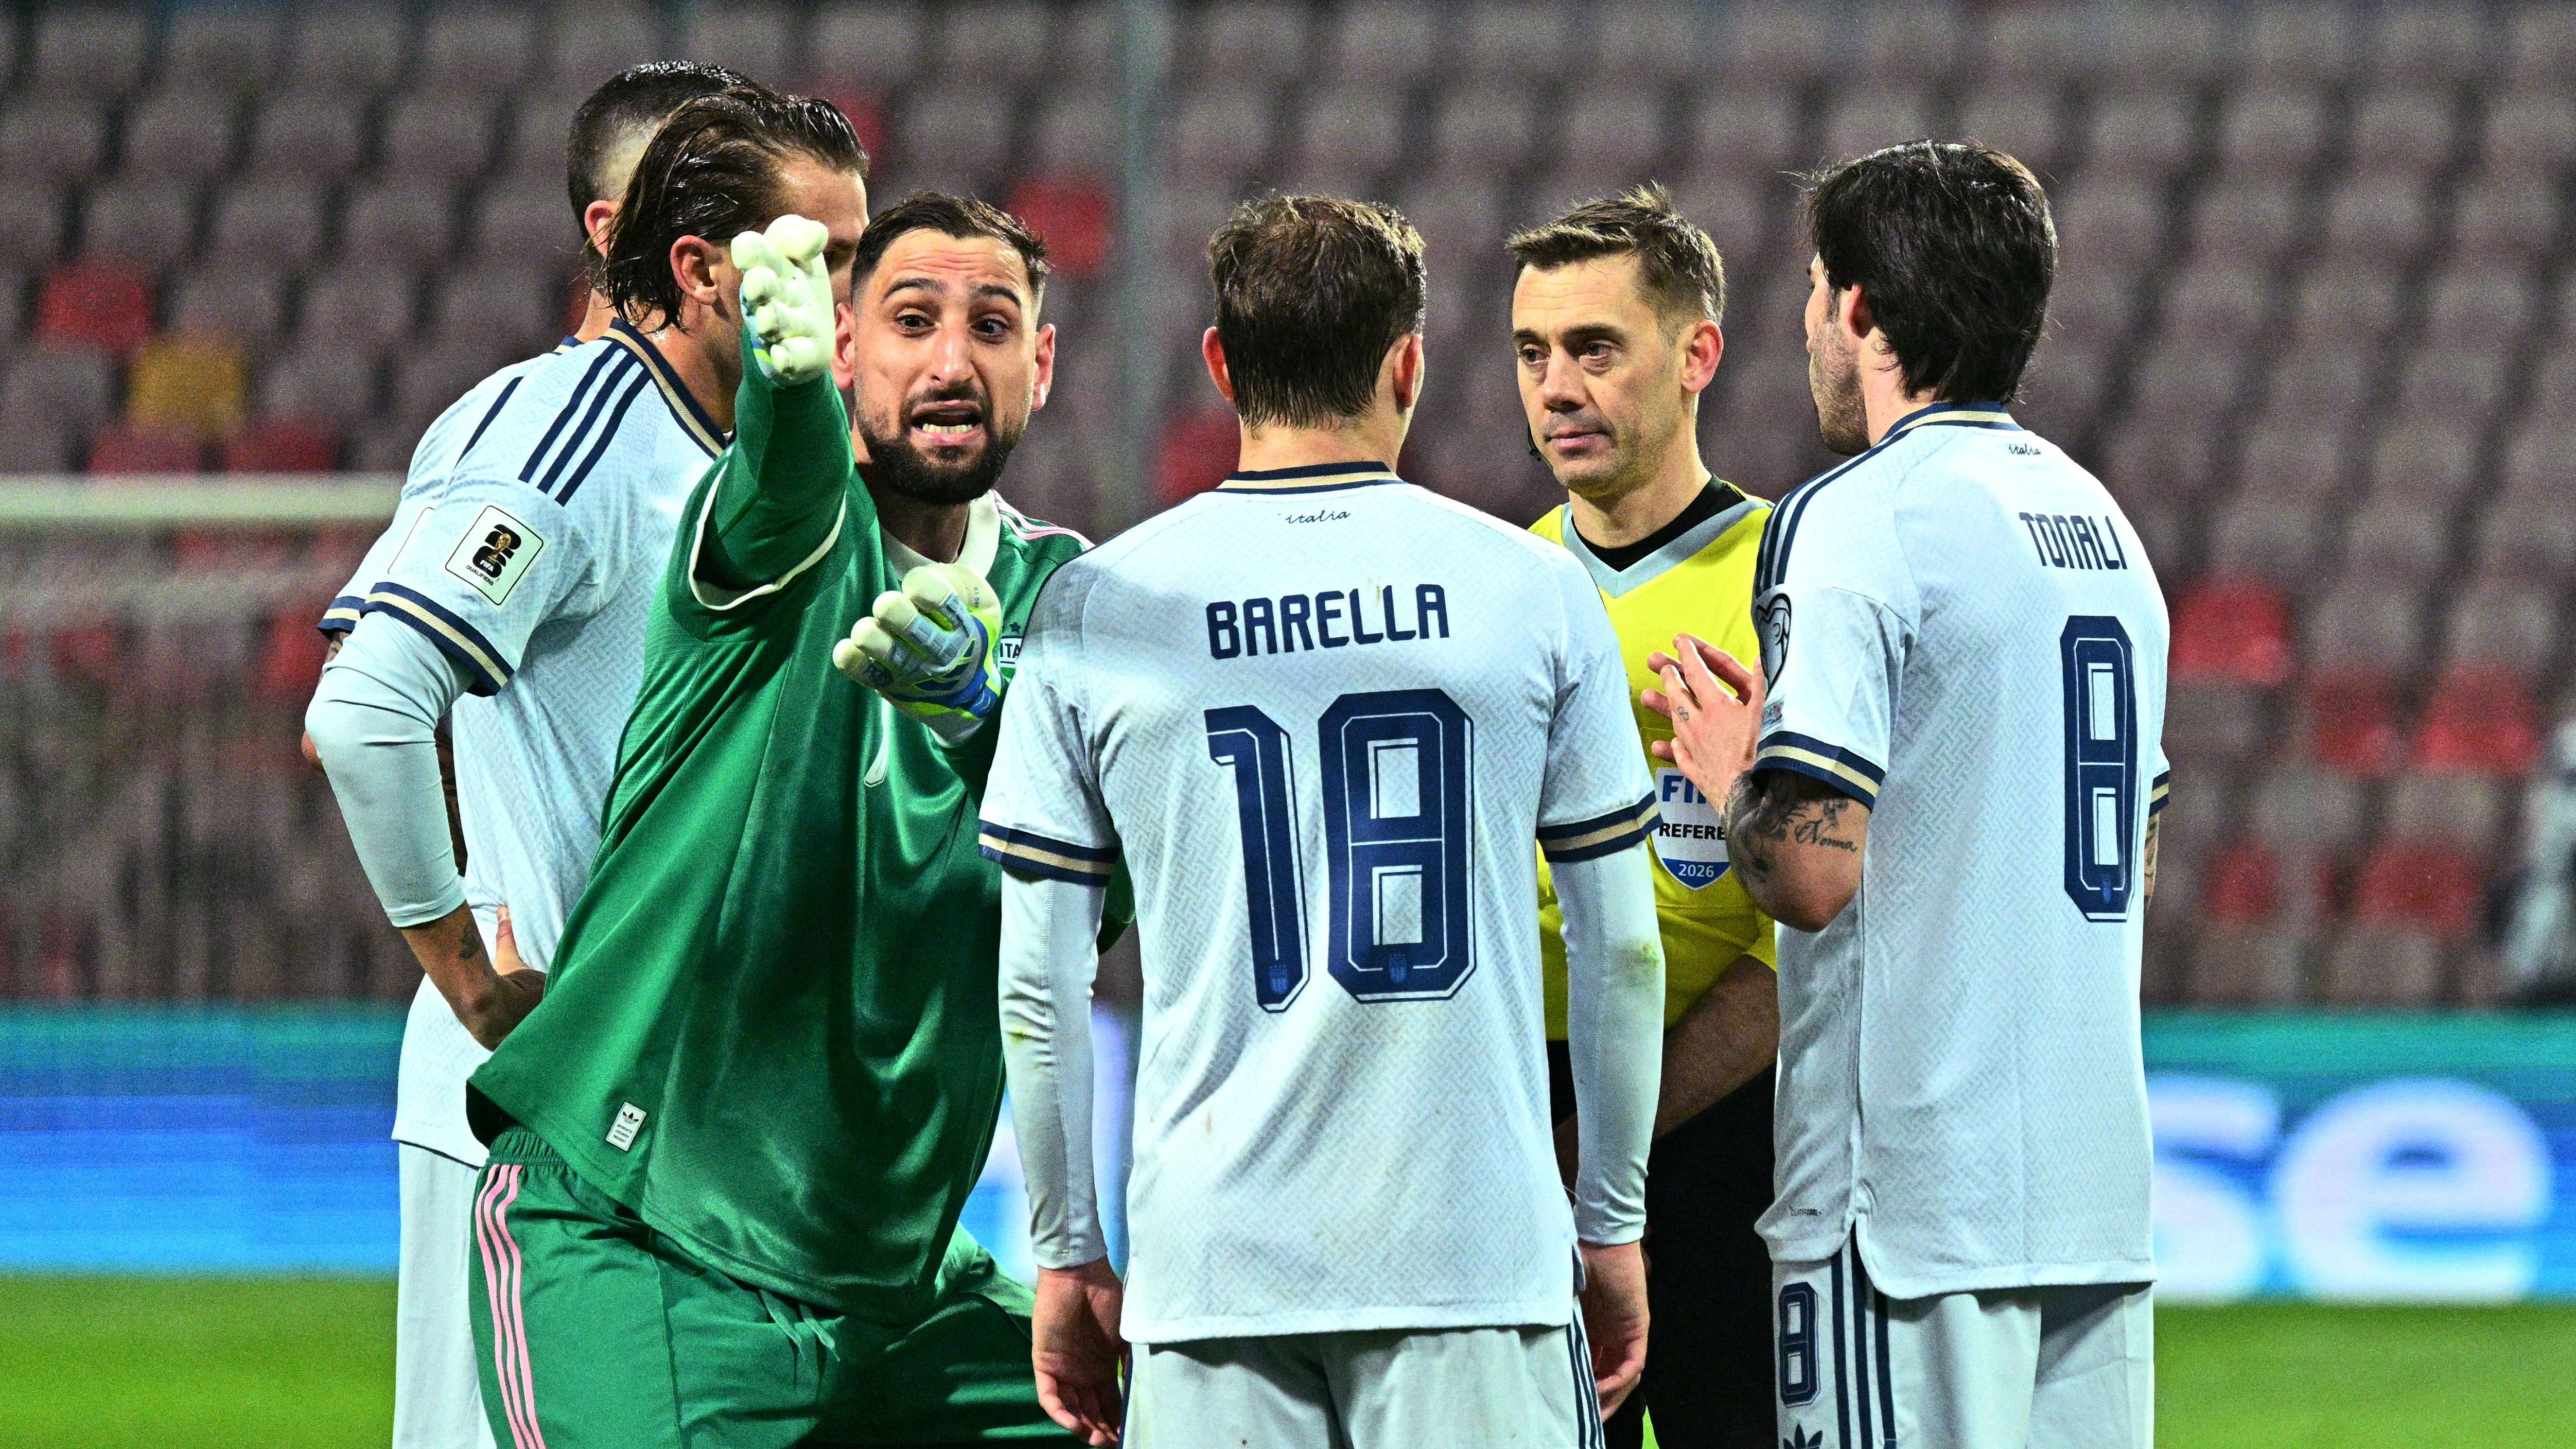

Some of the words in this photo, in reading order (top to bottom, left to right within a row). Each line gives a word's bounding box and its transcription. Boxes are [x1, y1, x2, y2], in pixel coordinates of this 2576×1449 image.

[2009, 443, 2041, 455] italia
[1285, 510, 1351, 523] italia
[2019, 512, 2128, 570] TONALI
[466, 565, 494, 586] QUALIFIERS
[479, 559, 494, 572] FIFA
[1206, 584, 1449, 660] BARELLA
[1000, 643, 1020, 658] ITA
[2060, 615, 2140, 922] 8
[1662, 775, 1706, 804] FI
[1659, 823, 1726, 840] REFERE
[1204, 688, 1476, 1013] 18
[1678, 864, 1714, 877] 2026
[1779, 1282, 1820, 1408] 8
